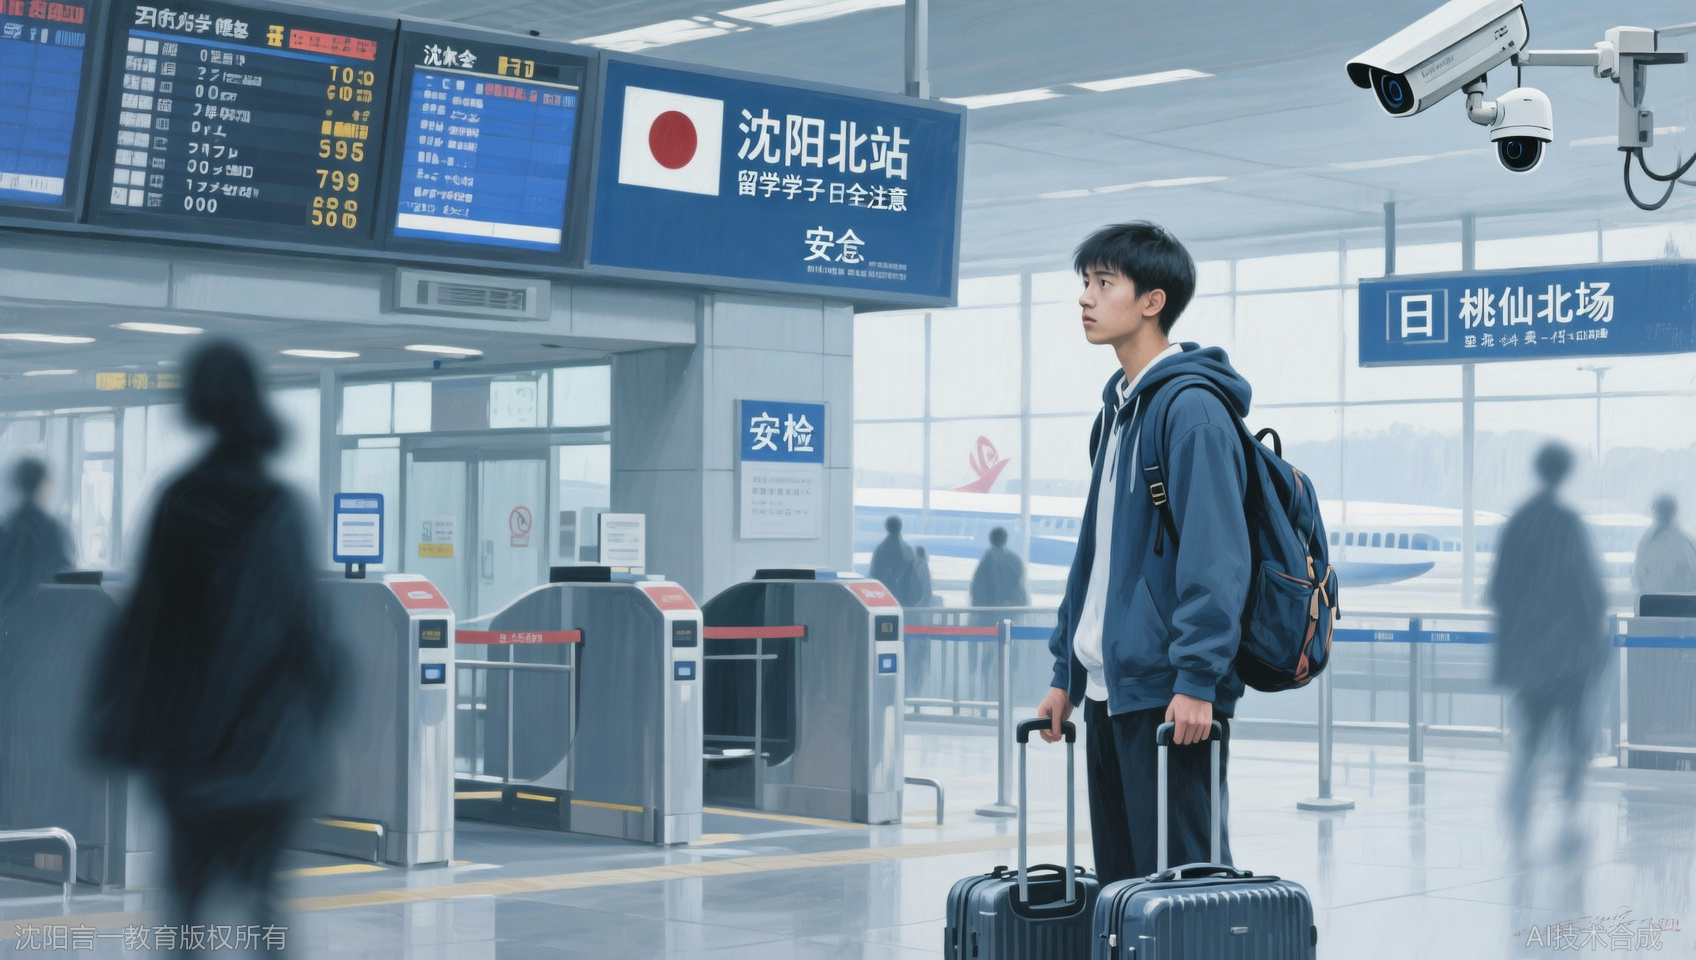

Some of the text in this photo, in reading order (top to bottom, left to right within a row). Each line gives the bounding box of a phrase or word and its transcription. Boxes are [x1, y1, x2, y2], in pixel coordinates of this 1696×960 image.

[318, 139, 365, 162] 595
[737, 108, 910, 180] 沈阳北站
[316, 169, 360, 192] 799
[1401, 294, 1433, 338] 日
[1458, 281, 1615, 330] 桃仙北场
[750, 411, 814, 453] 安检
